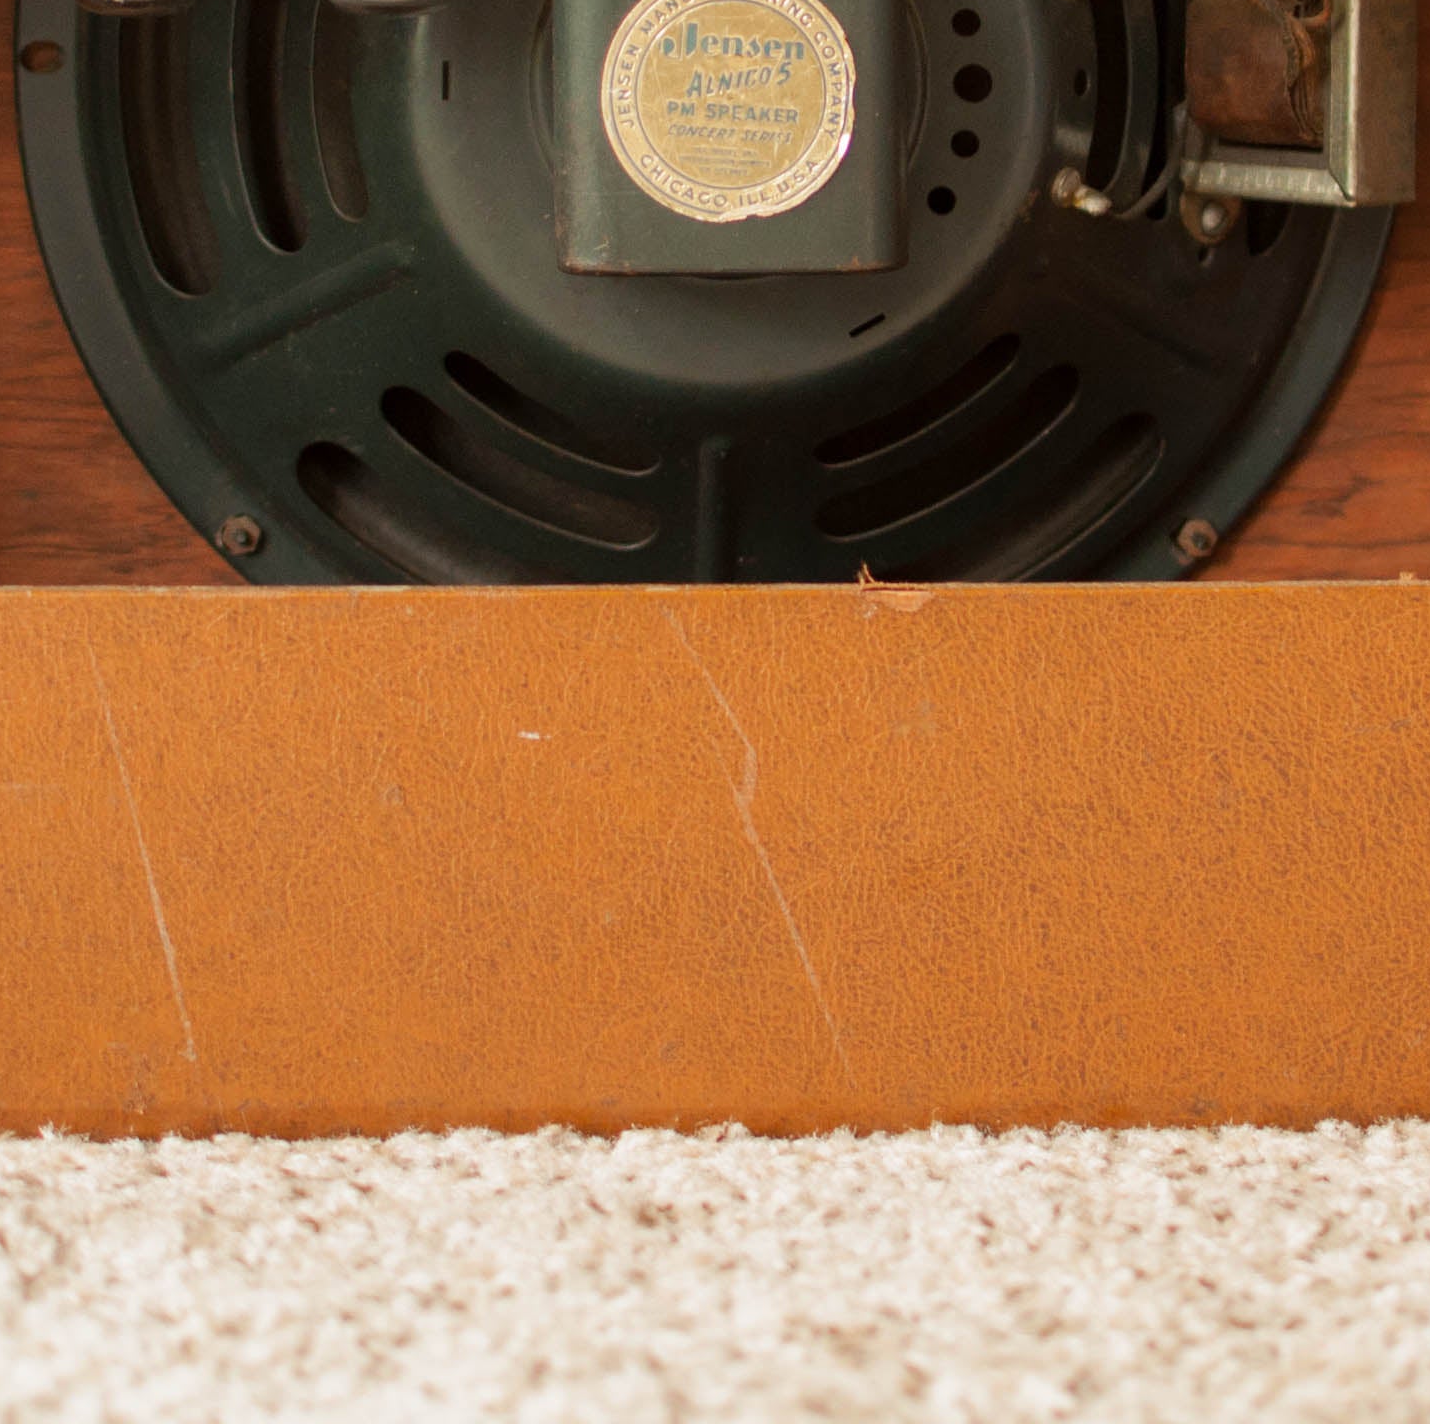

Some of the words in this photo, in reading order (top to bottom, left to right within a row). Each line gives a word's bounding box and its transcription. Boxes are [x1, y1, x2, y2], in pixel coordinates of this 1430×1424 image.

[658, 22, 806, 61] Jensen
[616, 44, 640, 129] JENSEN
[814, 31, 844, 139] COMPANY
[776, 61, 792, 87] 5
[666, 101, 696, 117] PM
[706, 102, 799, 124] SPEAKER
[667, 123, 737, 139] CONCERT
[640, 154, 728, 208] CHICAGO
